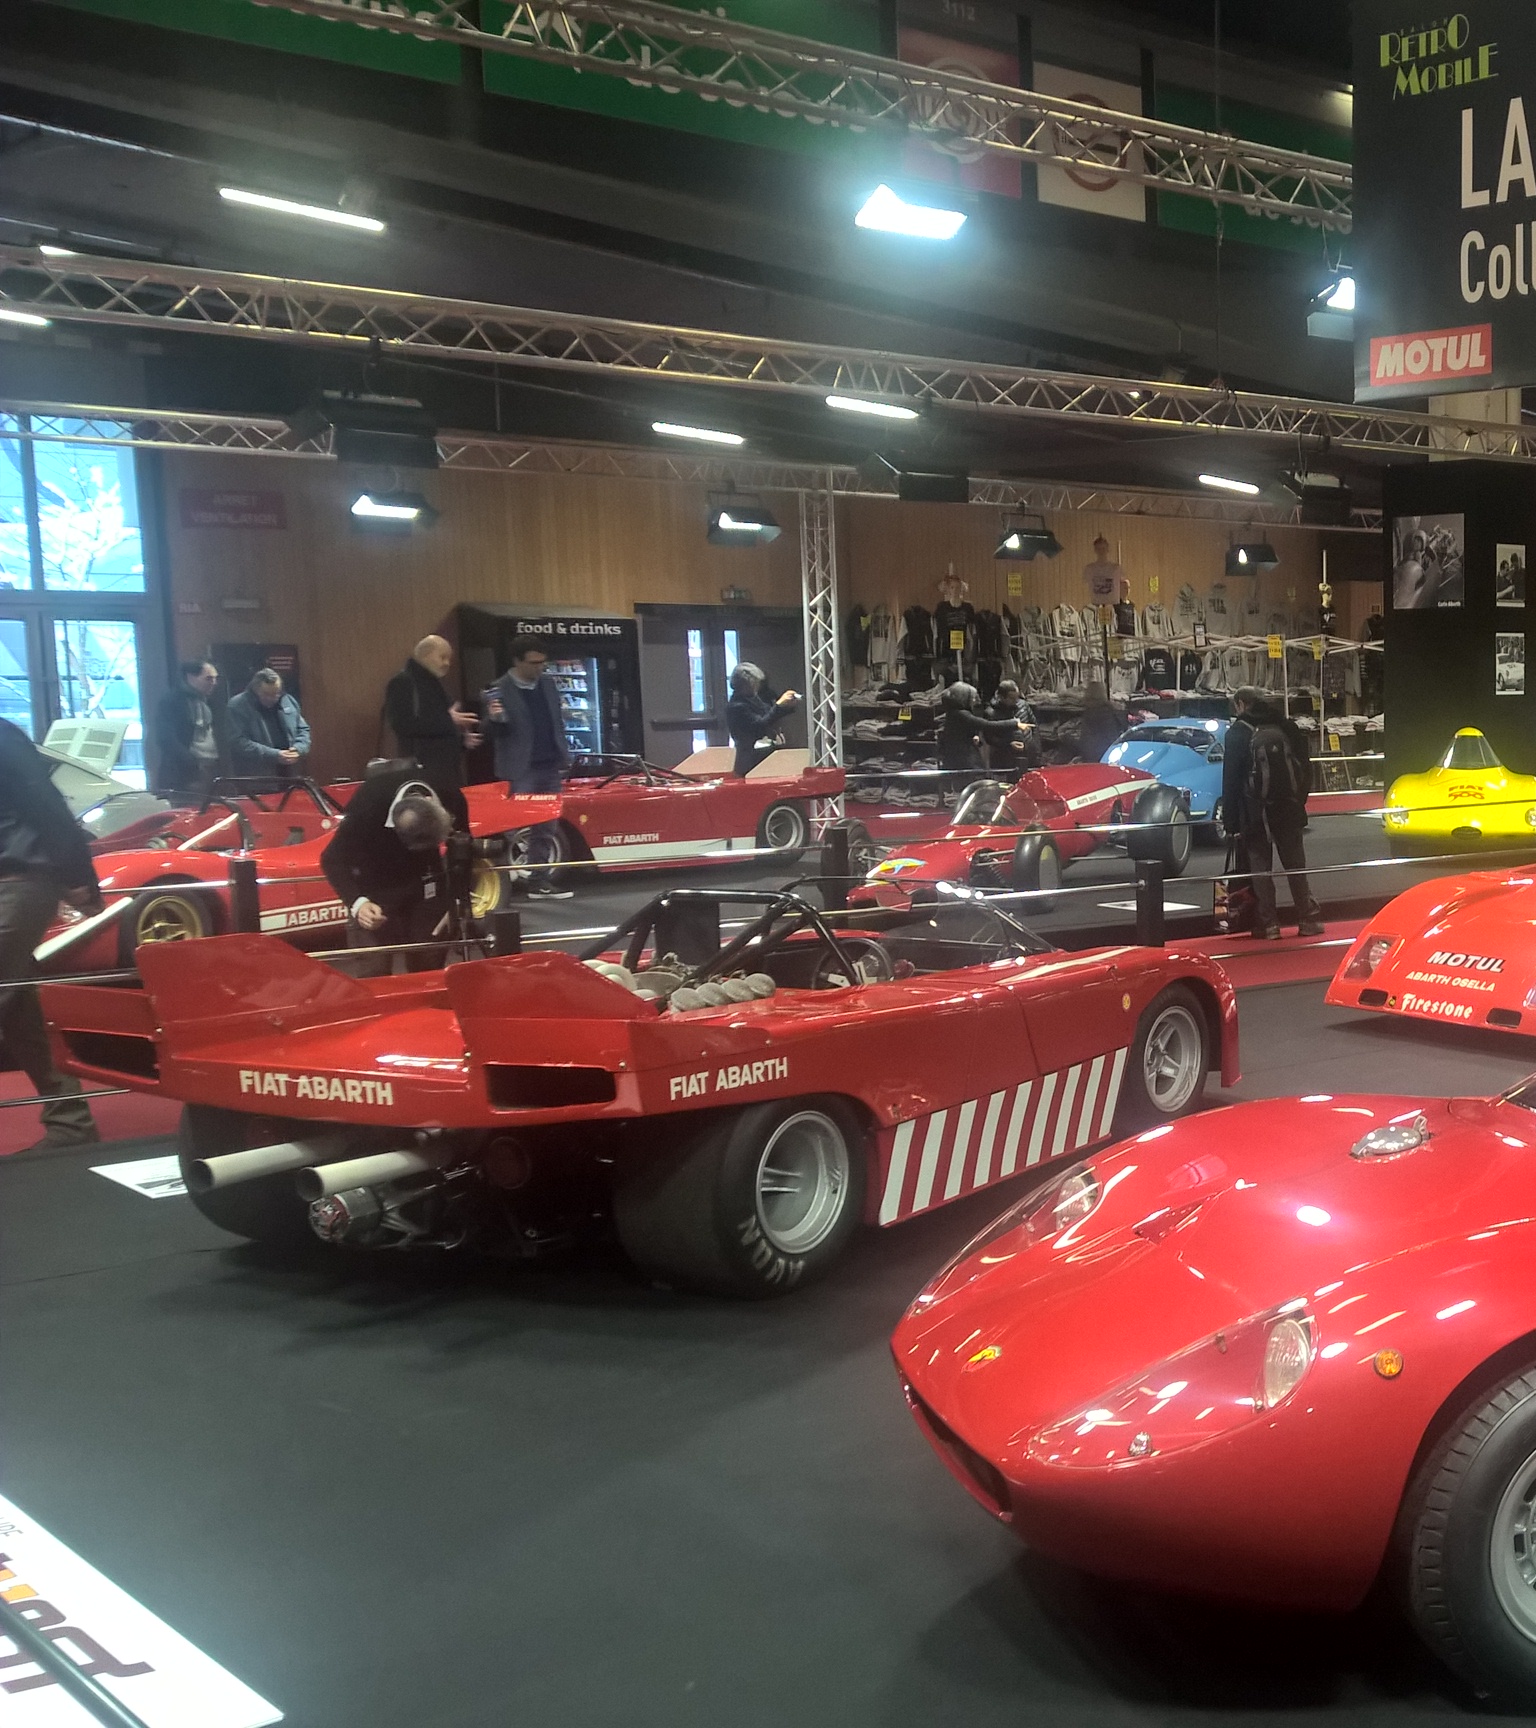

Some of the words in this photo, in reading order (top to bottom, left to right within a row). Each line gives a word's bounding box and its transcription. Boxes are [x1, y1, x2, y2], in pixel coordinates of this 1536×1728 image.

[1392, 42, 1499, 101] MOBILE
[1375, 332, 1487, 379] MOTUL
[516, 621, 552, 634] food
[556, 623, 567, 634] &
[569, 622, 621, 635] drinks
[603, 835, 623, 844] FIAT
[623, 833, 660, 843] ABARTH
[288, 905, 349, 926] ABARTH
[1426, 951, 1506, 973] MOTUL
[1405, 971, 1452, 985] ABARTH
[1451, 977, 1496, 992] OSELLA
[1400, 993, 1474, 1020] Firestone
[239, 1070, 289, 1097] FIAT
[296, 1075, 394, 1106] ABARTH
[669, 1070, 709, 1101] FIAT
[715, 1056, 788, 1092] ABARTH
